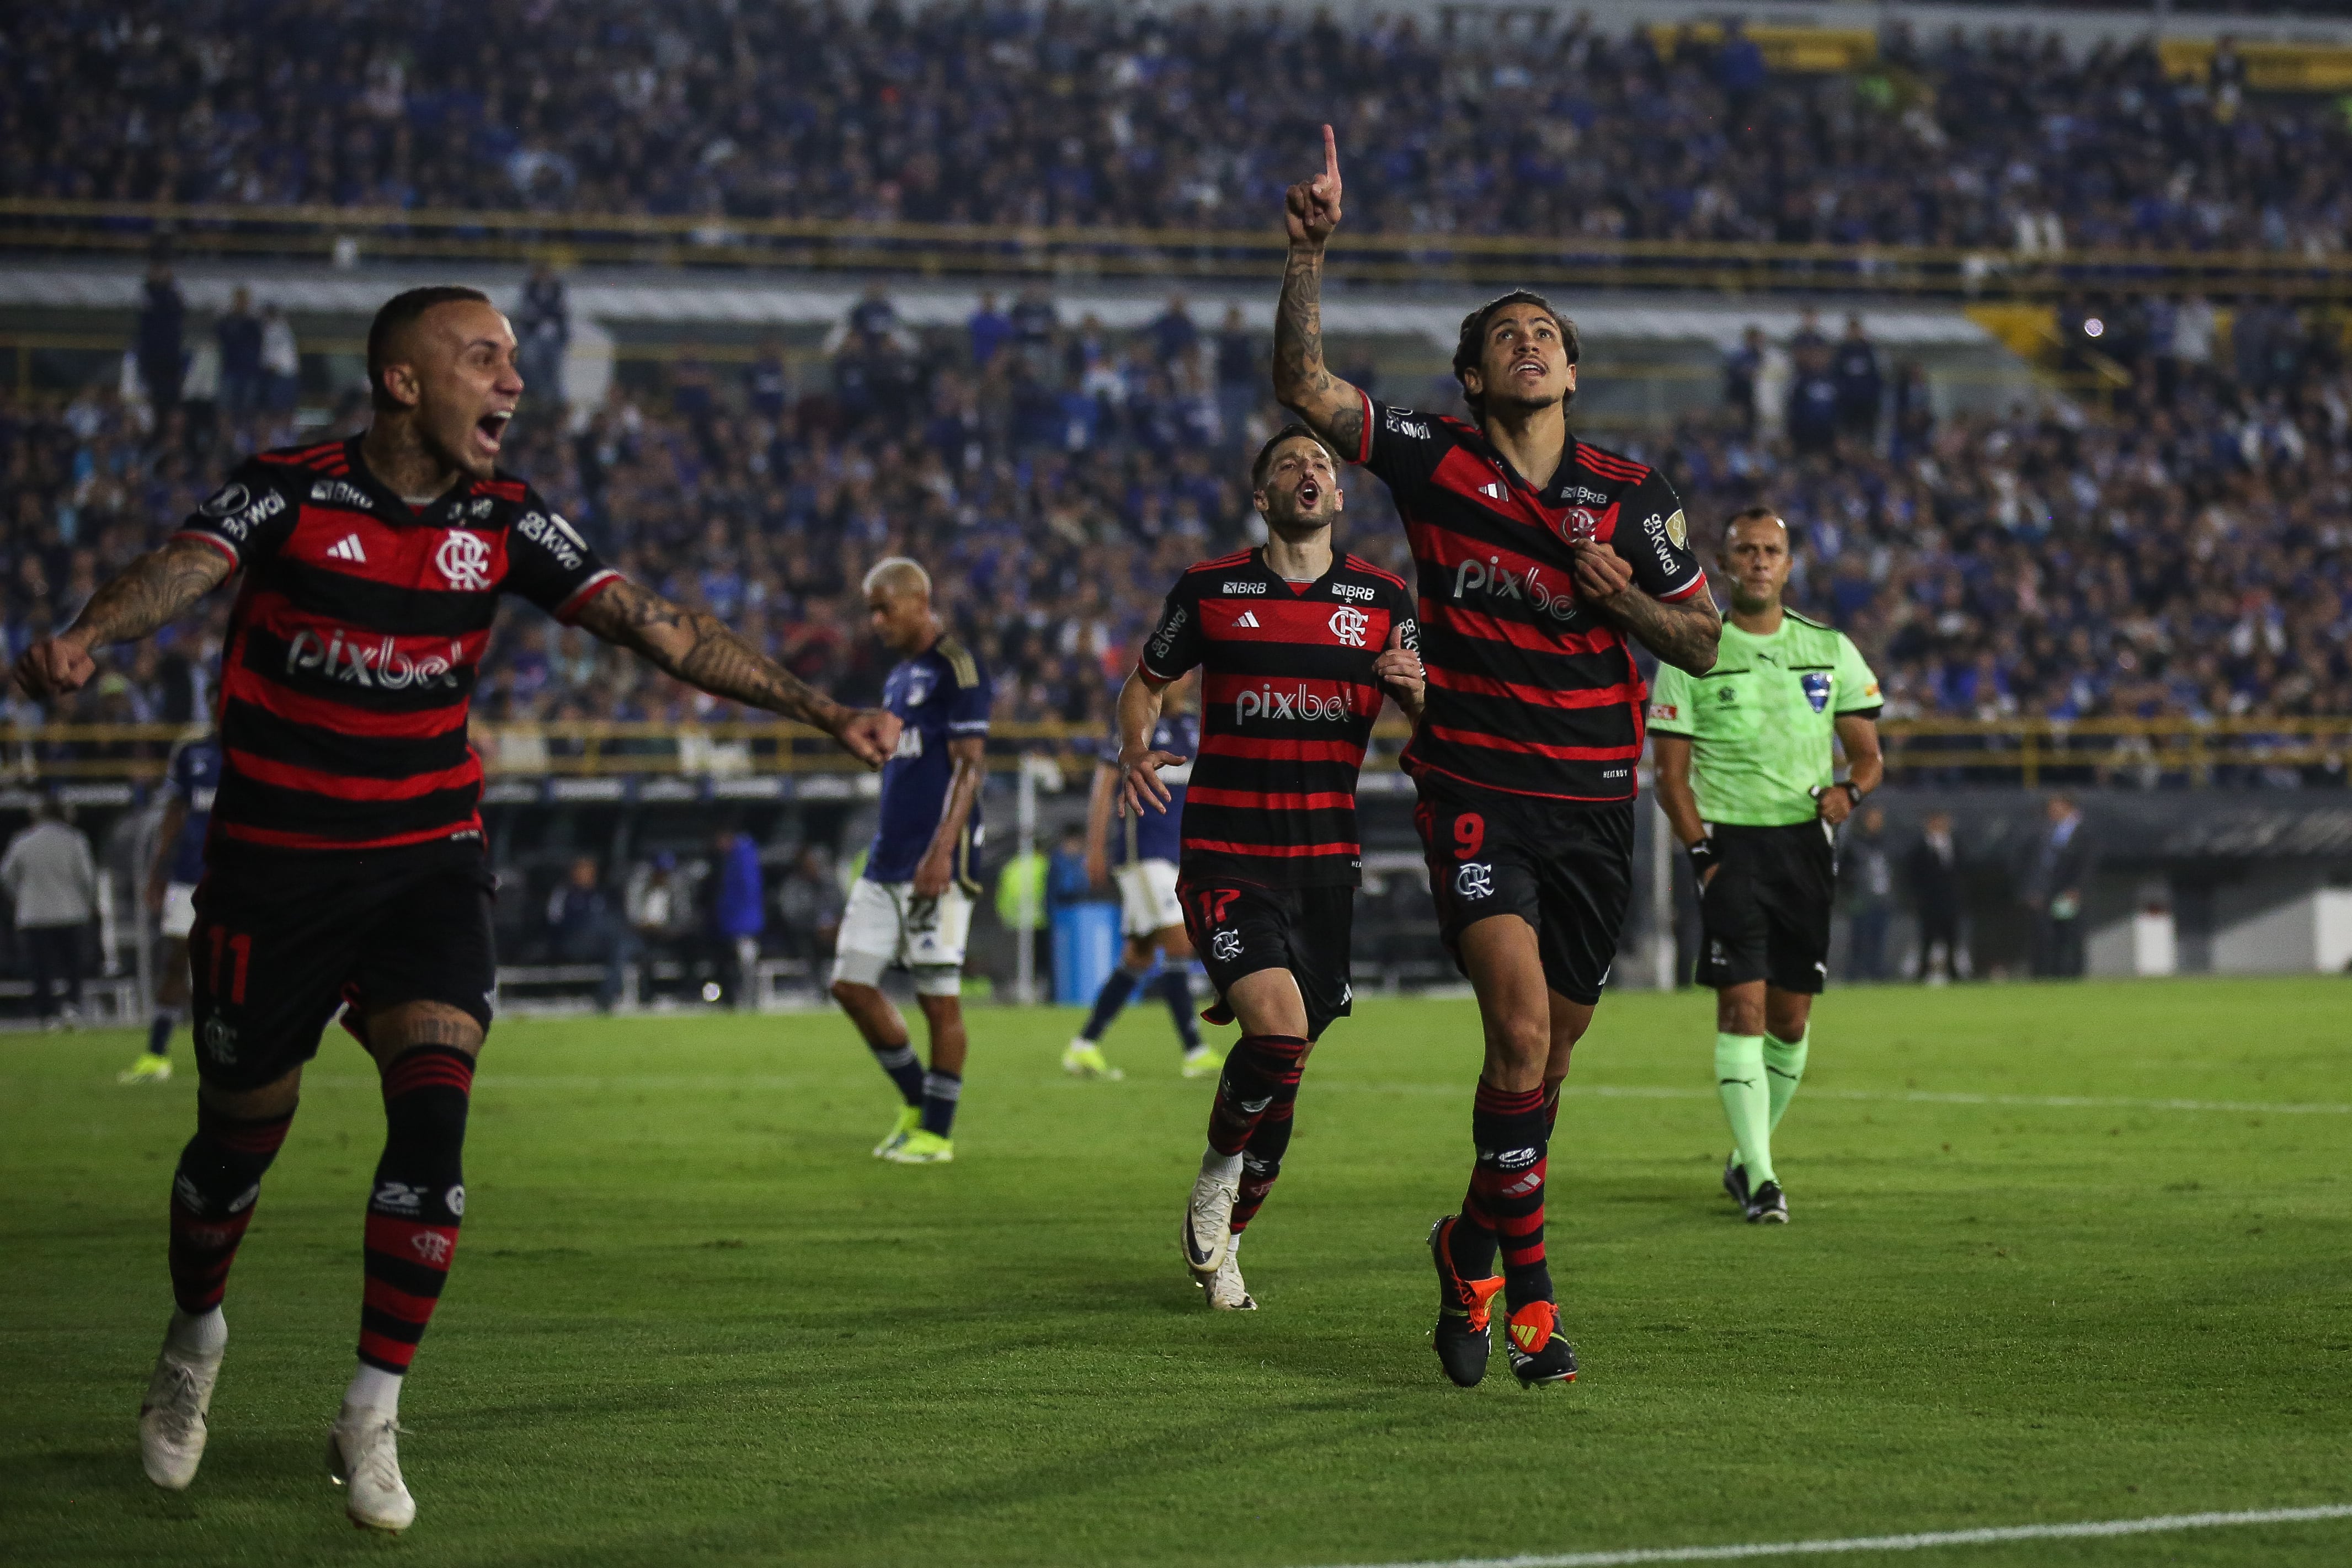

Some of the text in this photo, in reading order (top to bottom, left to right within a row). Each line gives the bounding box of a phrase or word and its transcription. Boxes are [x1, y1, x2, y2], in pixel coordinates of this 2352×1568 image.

[1577, 487, 1608, 504] BRB
[1238, 582, 1266, 594] BRB
[1346, 585, 1375, 601] BRB
[1453, 556, 1577, 621] pixbe
[1236, 683, 1352, 726] pixbet
[1454, 812, 1485, 860] 9
[1198, 889, 1241, 930] 17
[209, 925, 252, 1005] 11
